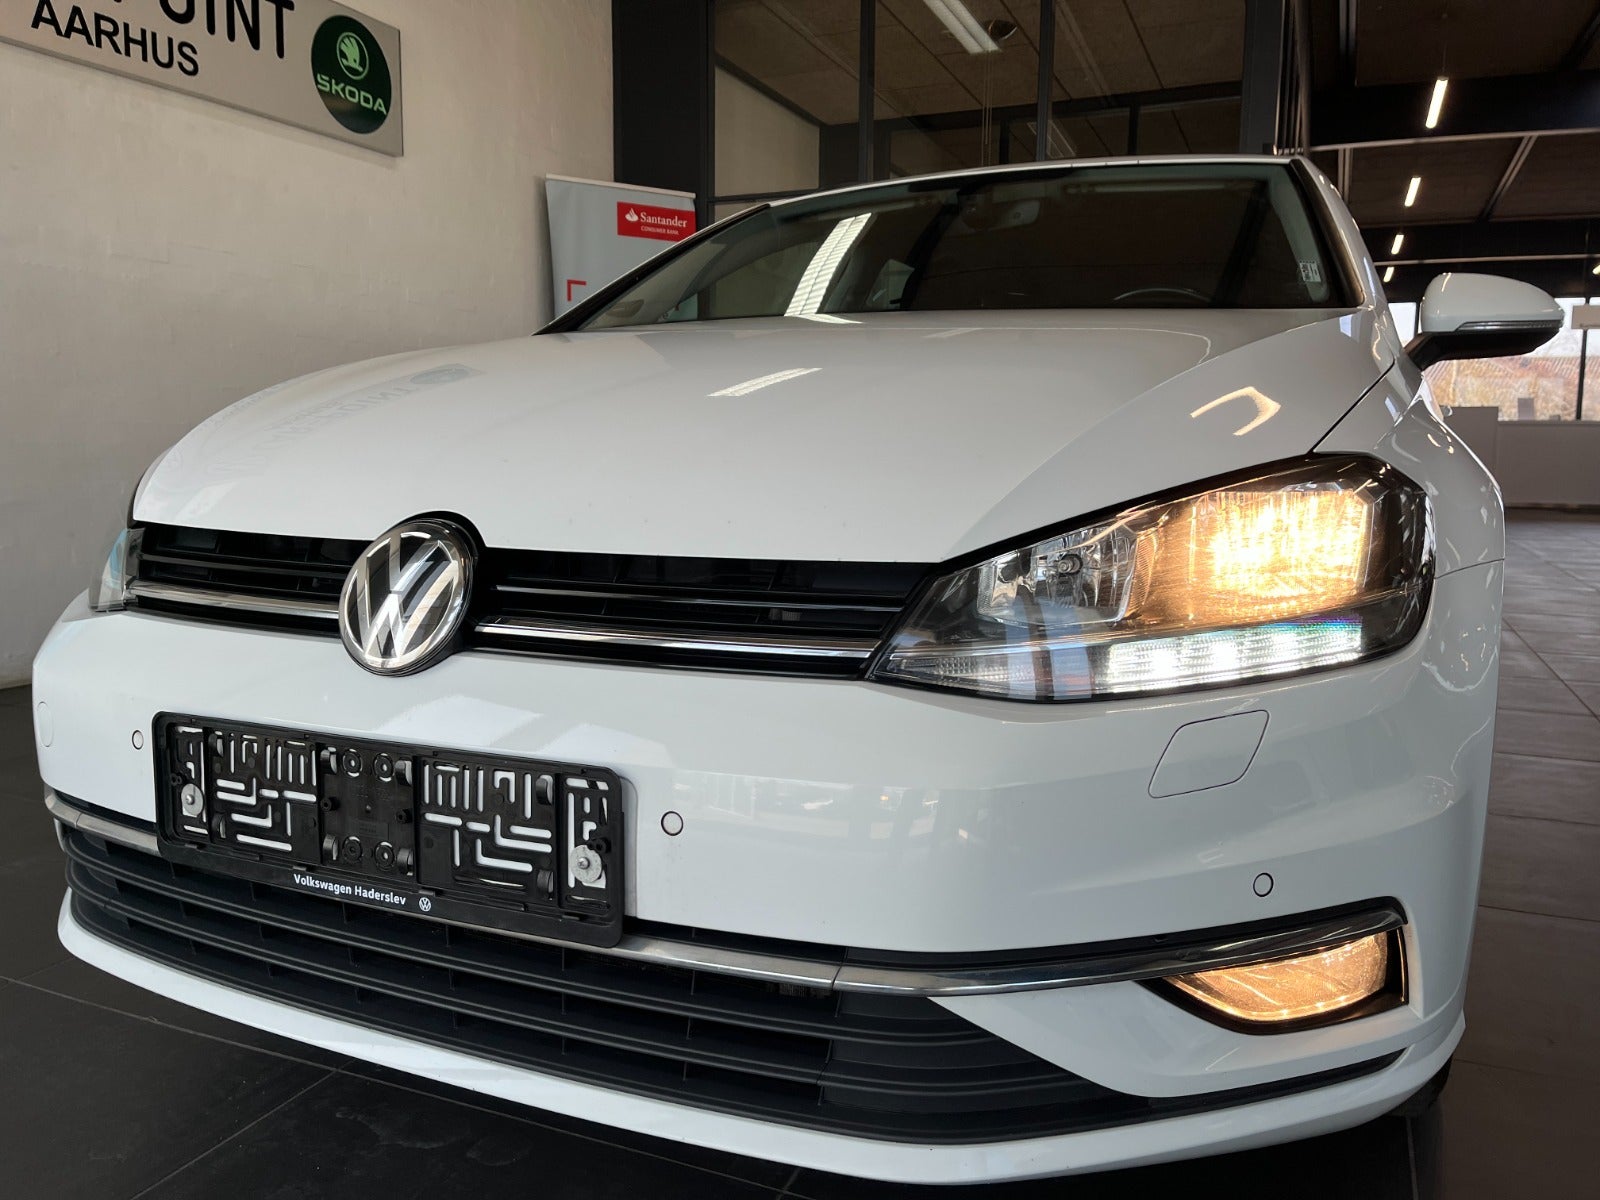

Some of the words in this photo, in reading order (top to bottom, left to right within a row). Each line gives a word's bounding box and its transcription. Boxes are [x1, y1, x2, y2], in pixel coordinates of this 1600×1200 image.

[31, 0, 200, 77] AARHUS
[115, 0, 295, 59] INT
[640, 212, 688, 228] Santander
[293, 873, 352, 895] Volkswagen
[354, 885, 406, 905] Haderslev
